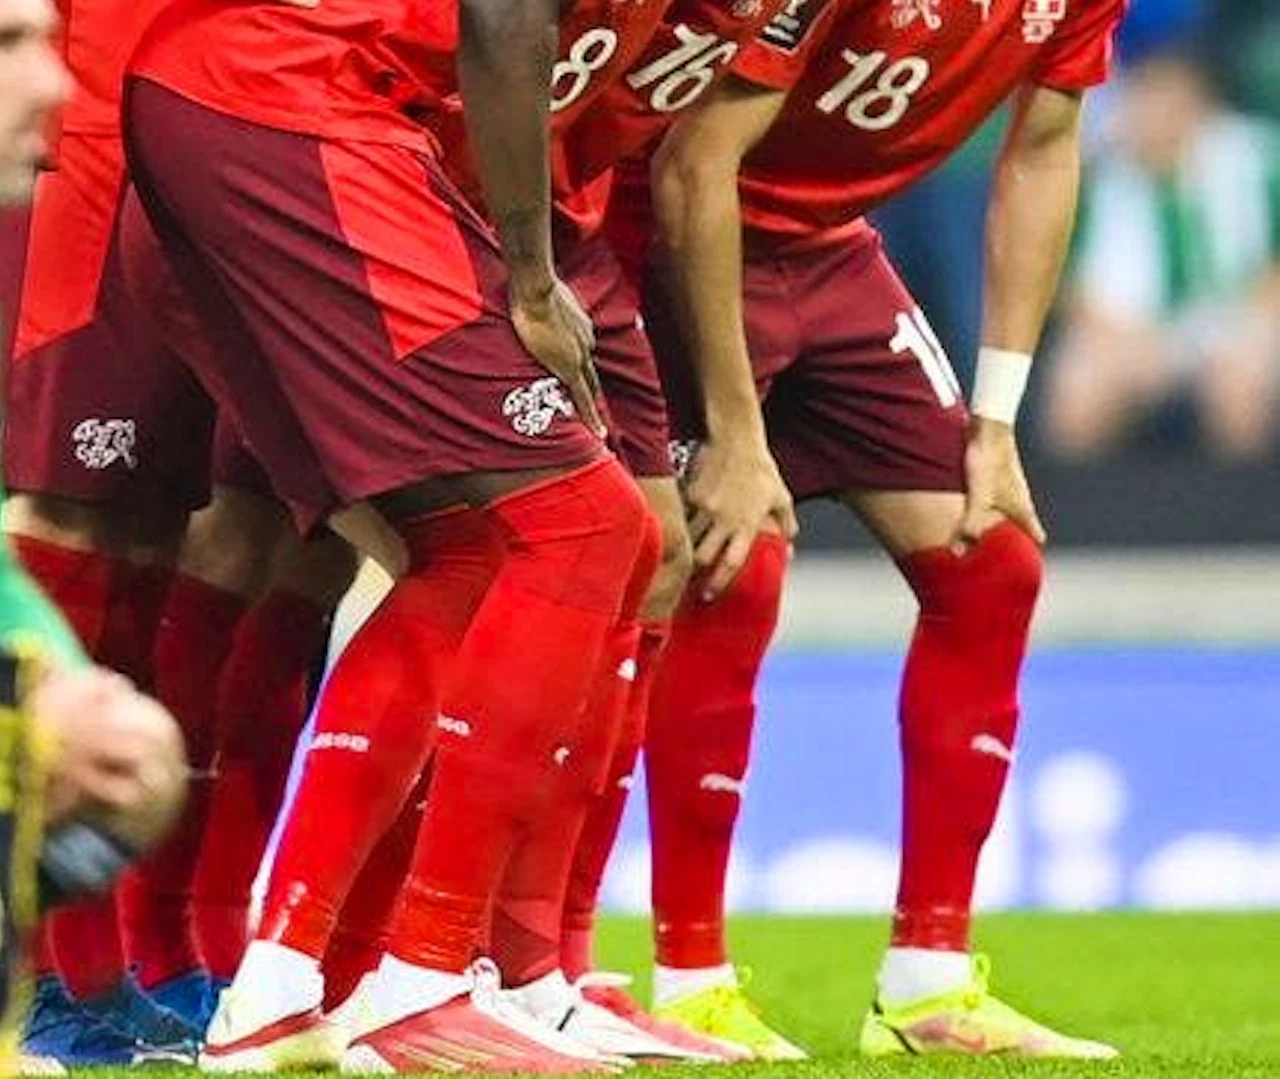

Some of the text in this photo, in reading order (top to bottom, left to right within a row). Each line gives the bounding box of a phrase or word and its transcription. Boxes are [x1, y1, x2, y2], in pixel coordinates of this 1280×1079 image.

[548, 28, 618, 112] 8
[626, 23, 738, 112] 16
[815, 47, 930, 131] 18
